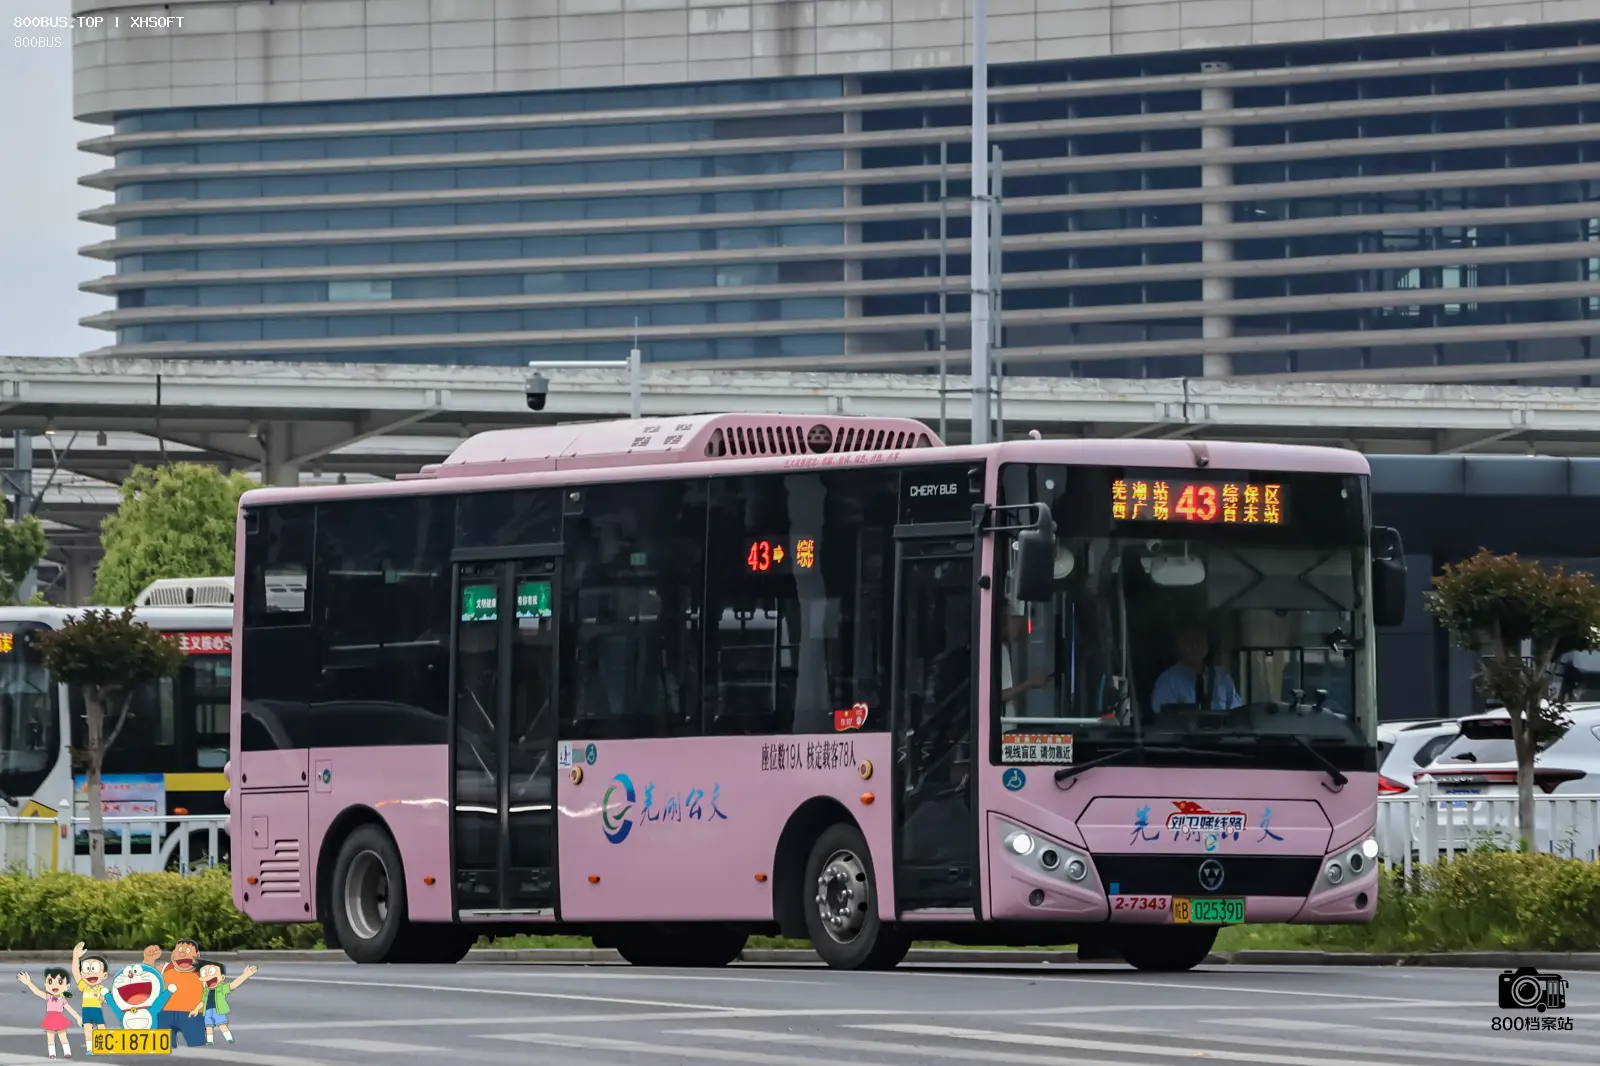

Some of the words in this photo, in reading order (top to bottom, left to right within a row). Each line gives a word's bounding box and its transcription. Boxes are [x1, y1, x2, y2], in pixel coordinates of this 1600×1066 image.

[910, 484, 939, 497] CHERY
[940, 483, 958, 495] BUS
[1112, 480, 1169, 501] 芜湖站
[1222, 484, 1281, 505] 综保区
[1112, 501, 1169, 520] 西广场
[1175, 485, 1218, 521] 43
[1222, 504, 1280, 524] 首末站
[747, 541, 770, 571] 43
[761, 742, 803, 771] 座位数19人
[806, 740, 857, 770] 核定载客78人
[1004, 745, 1037, 760] 视线盲区
[1040, 745, 1071, 760] 请勿靠近
[640, 780, 728, 827] 芜湖公交
[1114, 897, 1167, 910] 2-7343
